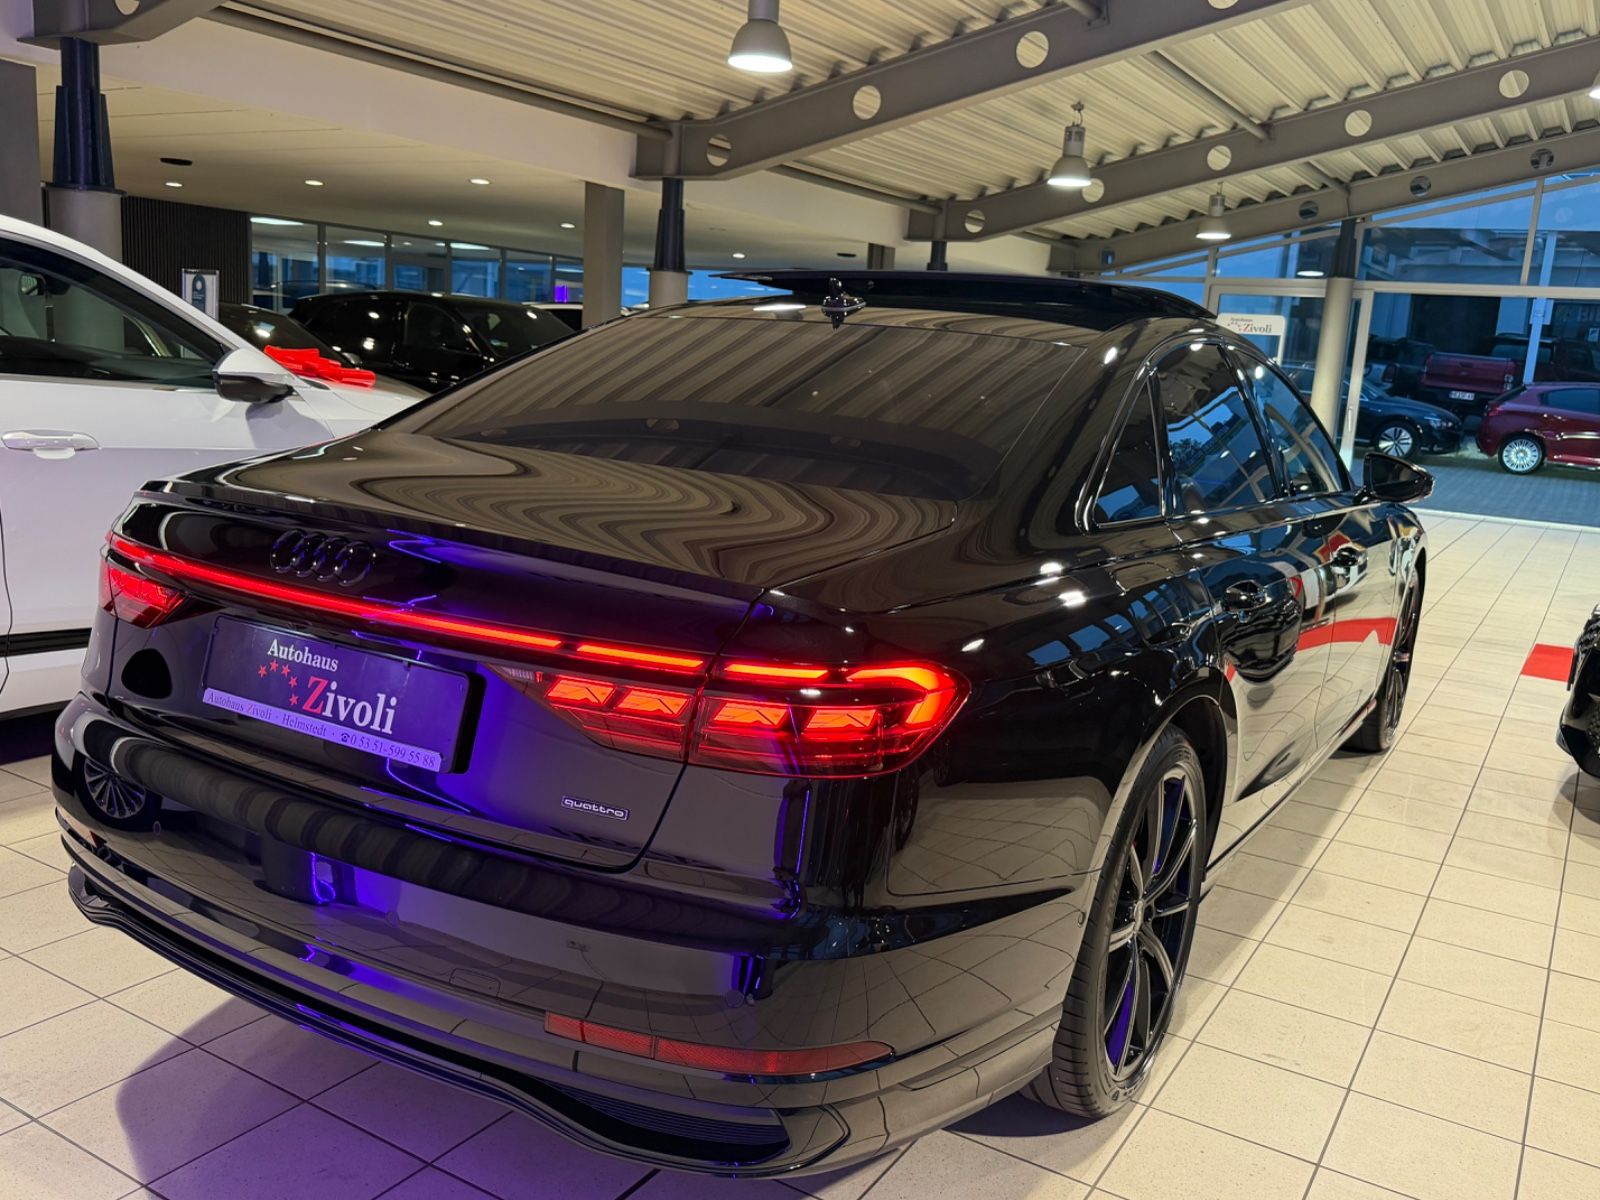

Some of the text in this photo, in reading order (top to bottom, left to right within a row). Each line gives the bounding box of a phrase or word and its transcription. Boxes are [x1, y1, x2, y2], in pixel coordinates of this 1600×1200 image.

[267, 638, 339, 672] Autohaus
[302, 675, 398, 735] Zivoli
[207, 692, 244, 712] Autohaus
[246, 704, 272, 720] Zivoli
[281, 713, 327, 737] Helmstedt
[408, 751, 420, 762] 55
[422, 755, 436, 767] 88
[564, 799, 624, 817] quattro
